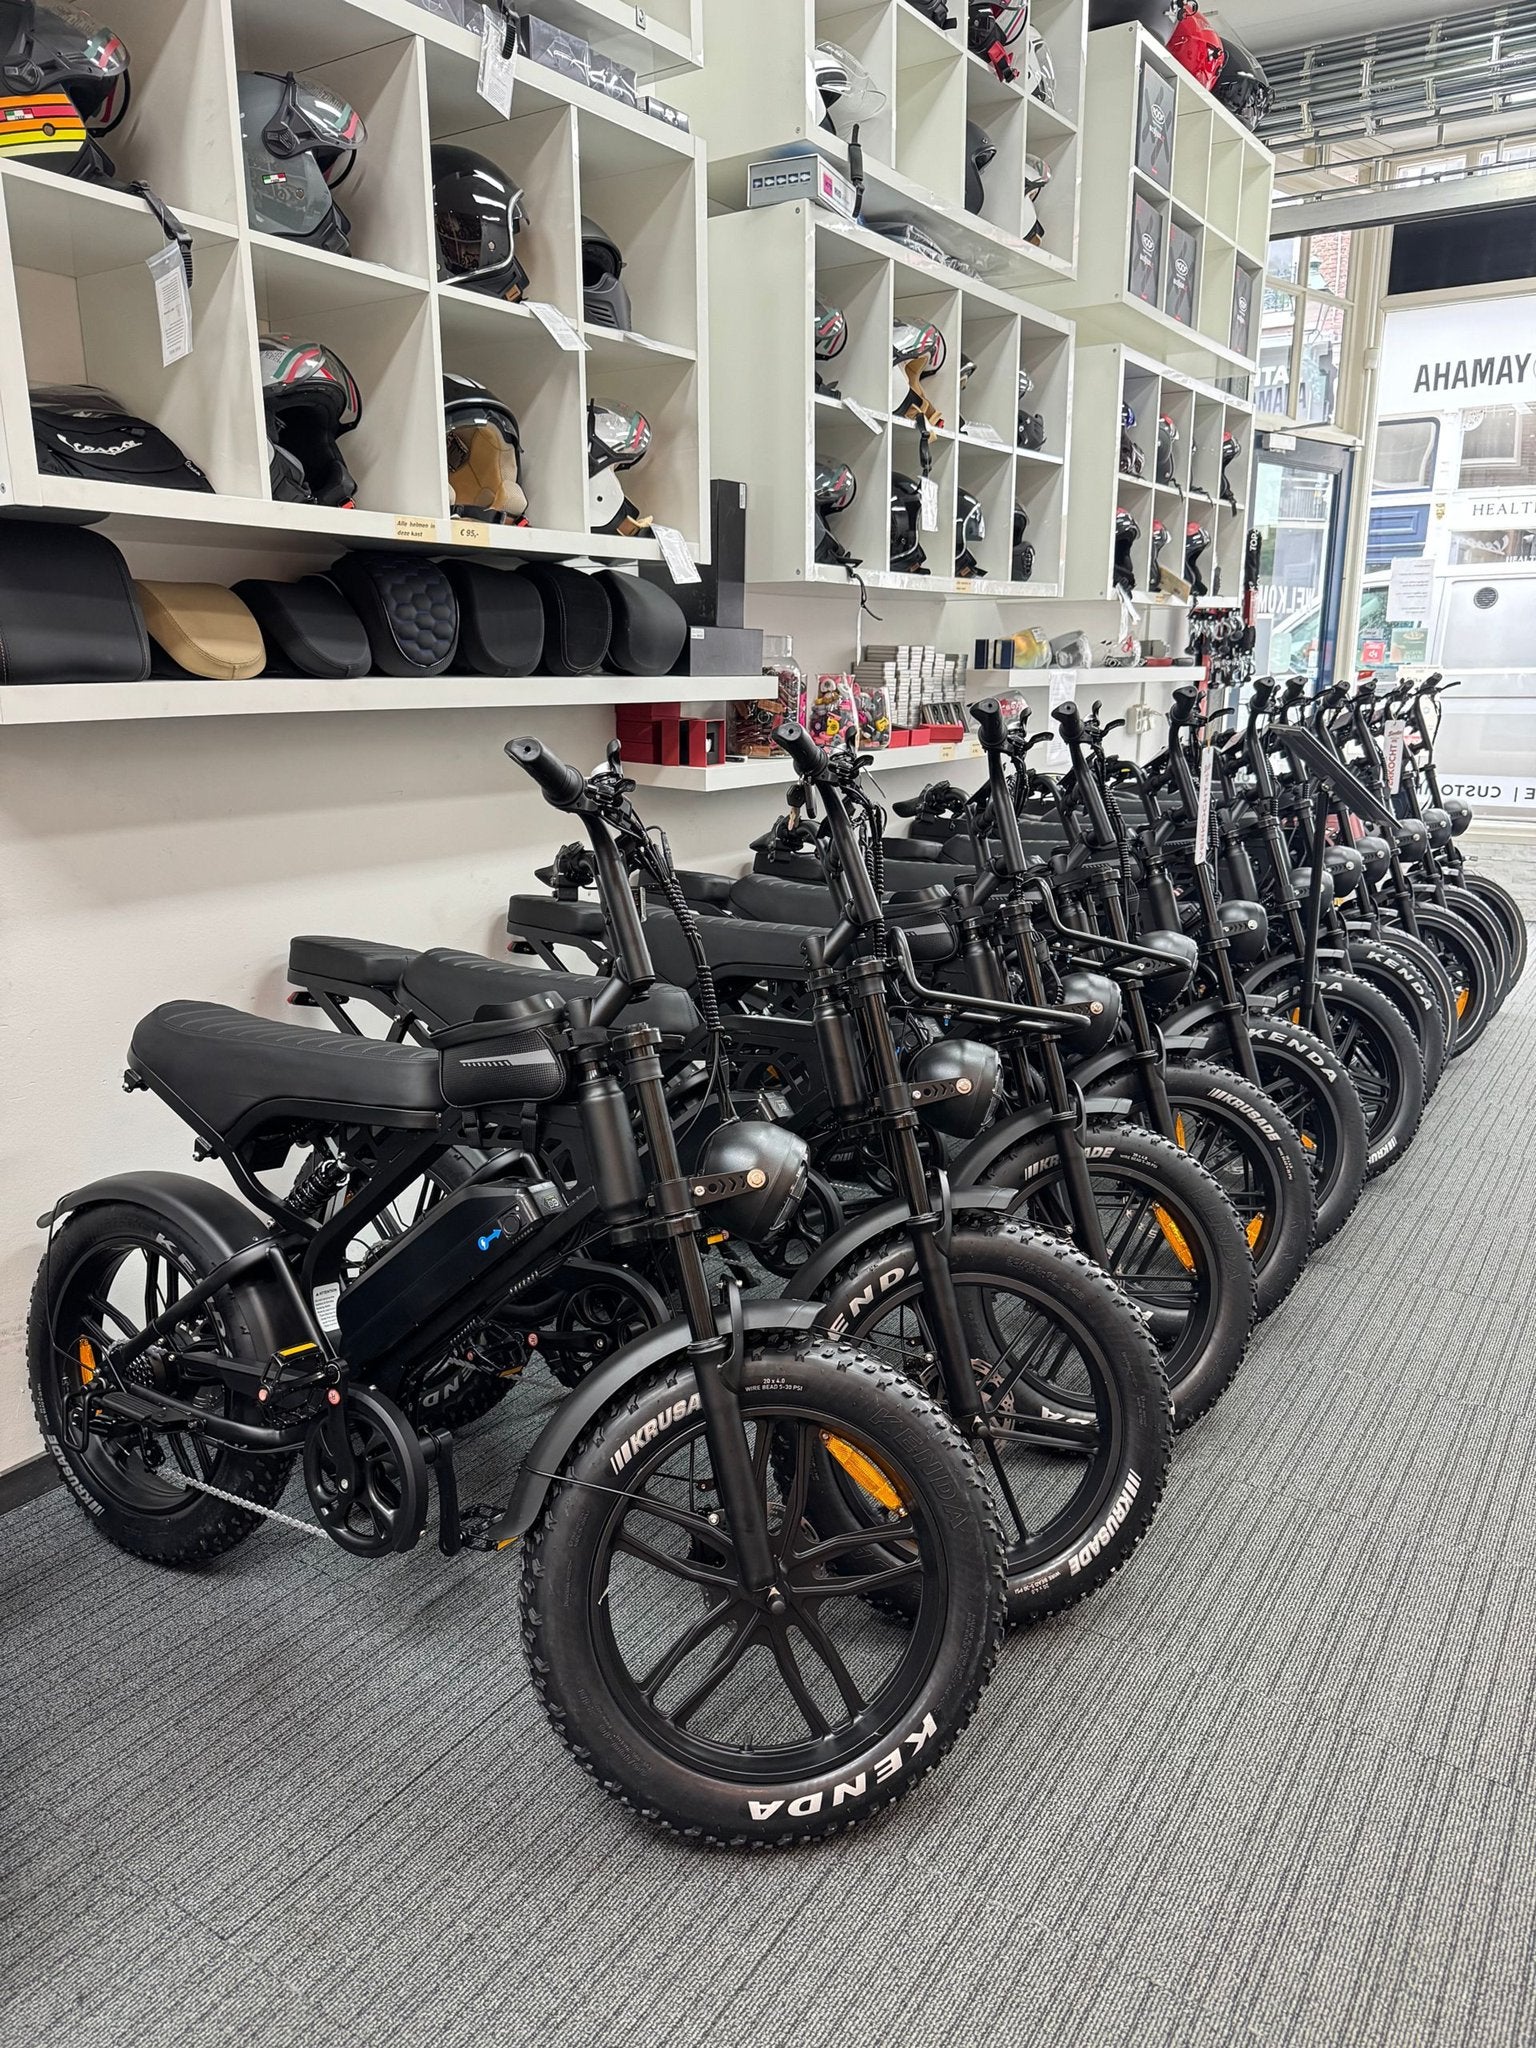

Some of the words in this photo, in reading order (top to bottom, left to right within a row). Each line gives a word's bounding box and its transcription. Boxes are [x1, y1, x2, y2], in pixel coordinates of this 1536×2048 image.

[56, 433, 143, 456] Vespa
[1472, 501, 1536, 516] HEALT
[1366, 951, 1433, 1011] KENDA
[1248, 1028, 1338, 1083] KENDA
[1220, 1094, 1282, 1142] KRUSADE
[630, 1392, 702, 1456] KRUSA
[46, 1434, 94, 1505] KRUSADE
[1067, 1488, 1134, 1577] KRUSADE
[748, 1712, 938, 1821] KENDA
